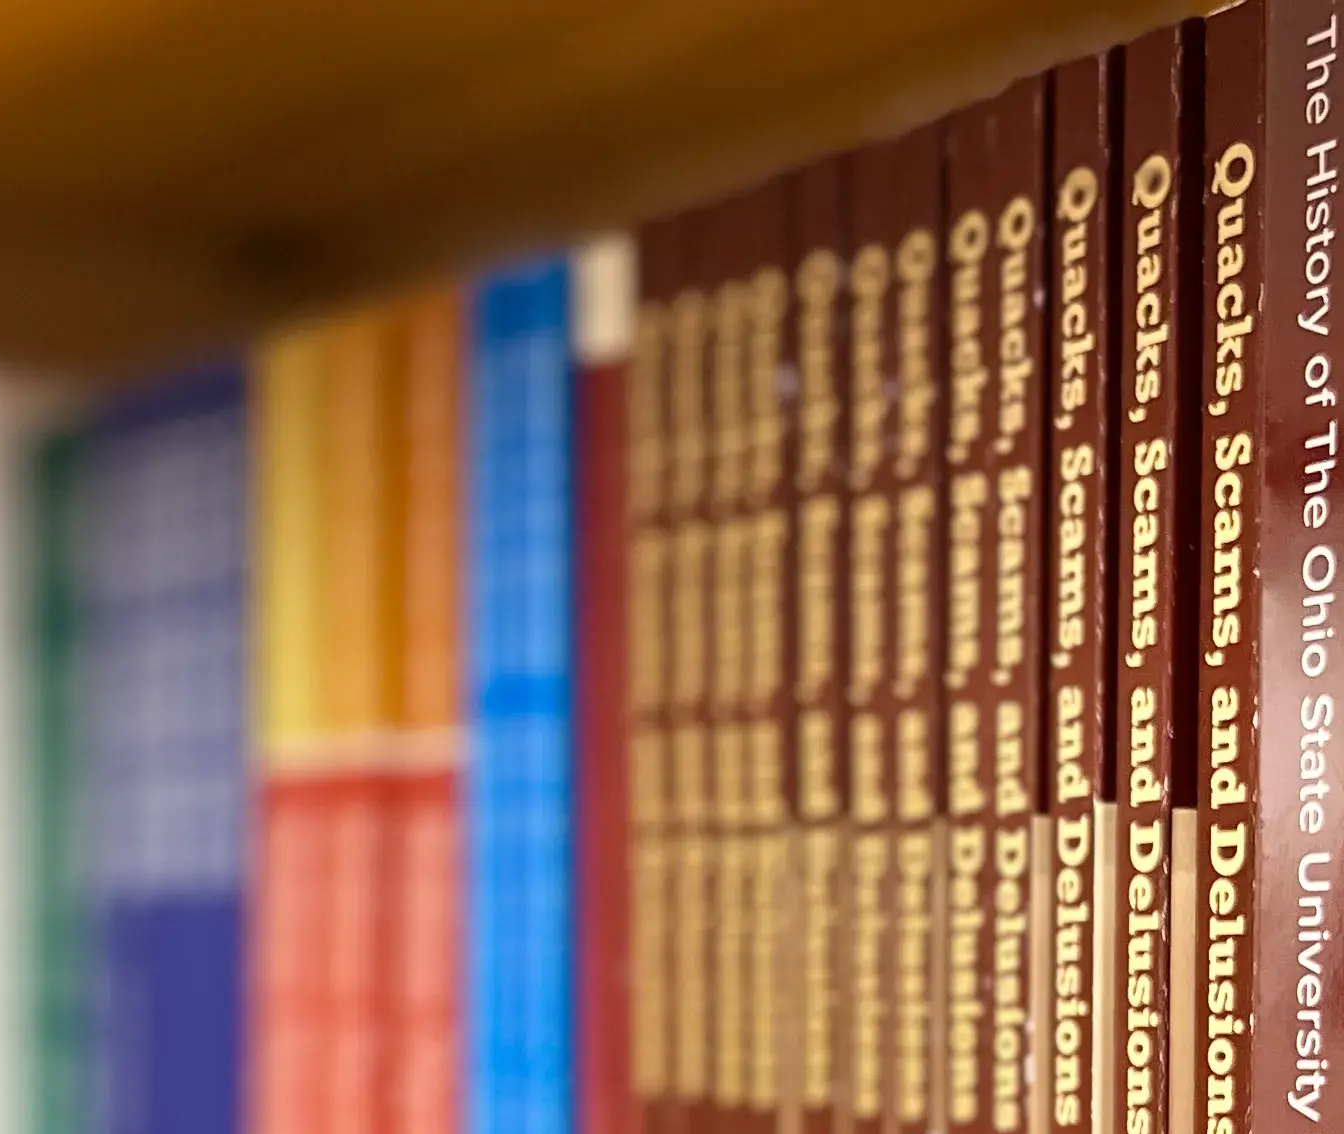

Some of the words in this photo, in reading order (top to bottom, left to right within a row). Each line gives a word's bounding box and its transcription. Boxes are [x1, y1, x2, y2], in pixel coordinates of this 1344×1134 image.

[1304, 16, 1338, 125] The
[1054, 166, 1098, 430] Quacks,
[1128, 154, 1172, 424] Quacks,
[1207, 142, 1255, 417] Quacks,
[1298, 139, 1338, 337] History
[1303, 420, 1338, 530] The
[1304, 355, 1335, 408] of
[1051, 443, 1094, 669] Scams,
[1124, 438, 1168, 669] Scams,
[1204, 432, 1253, 668] Scams,
[1301, 542, 1337, 678] Ohio
[1056, 686, 1090, 804] and
[1128, 686, 1163, 809] and
[1209, 686, 1247, 808] and
[1299, 691, 1333, 835] State
[1055, 816, 1089, 1127] Delusions
[1287, 852, 1331, 1122] University
